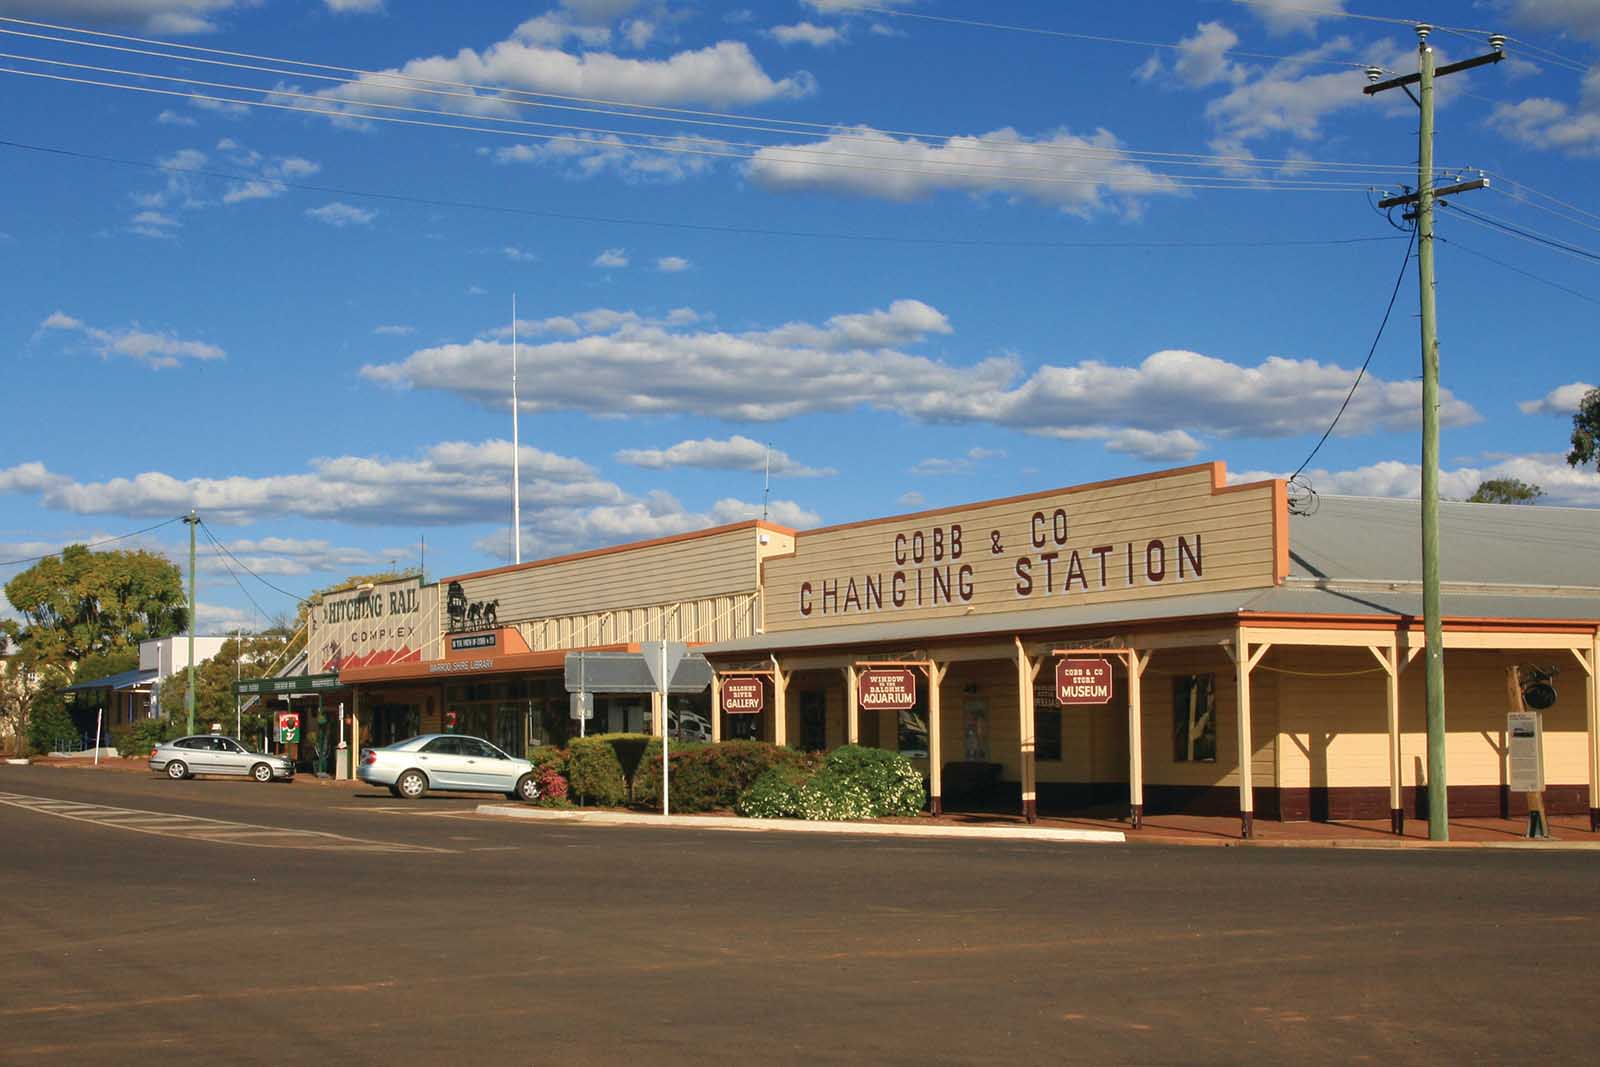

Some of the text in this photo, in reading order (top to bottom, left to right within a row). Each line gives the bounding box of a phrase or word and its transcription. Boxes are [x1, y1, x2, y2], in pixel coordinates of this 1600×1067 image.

[895, 508, 1068, 566] COBB & CO
[799, 534, 1203, 616] CHANGING STATION
[328, 588, 419, 624] HITCHING RAIL
[351, 626, 415, 642] COMPLEX
[863, 693, 912, 704] AQUARIUM
[1061, 685, 1107, 697] MUSEUM
[726, 698, 759, 708] GALLERY
